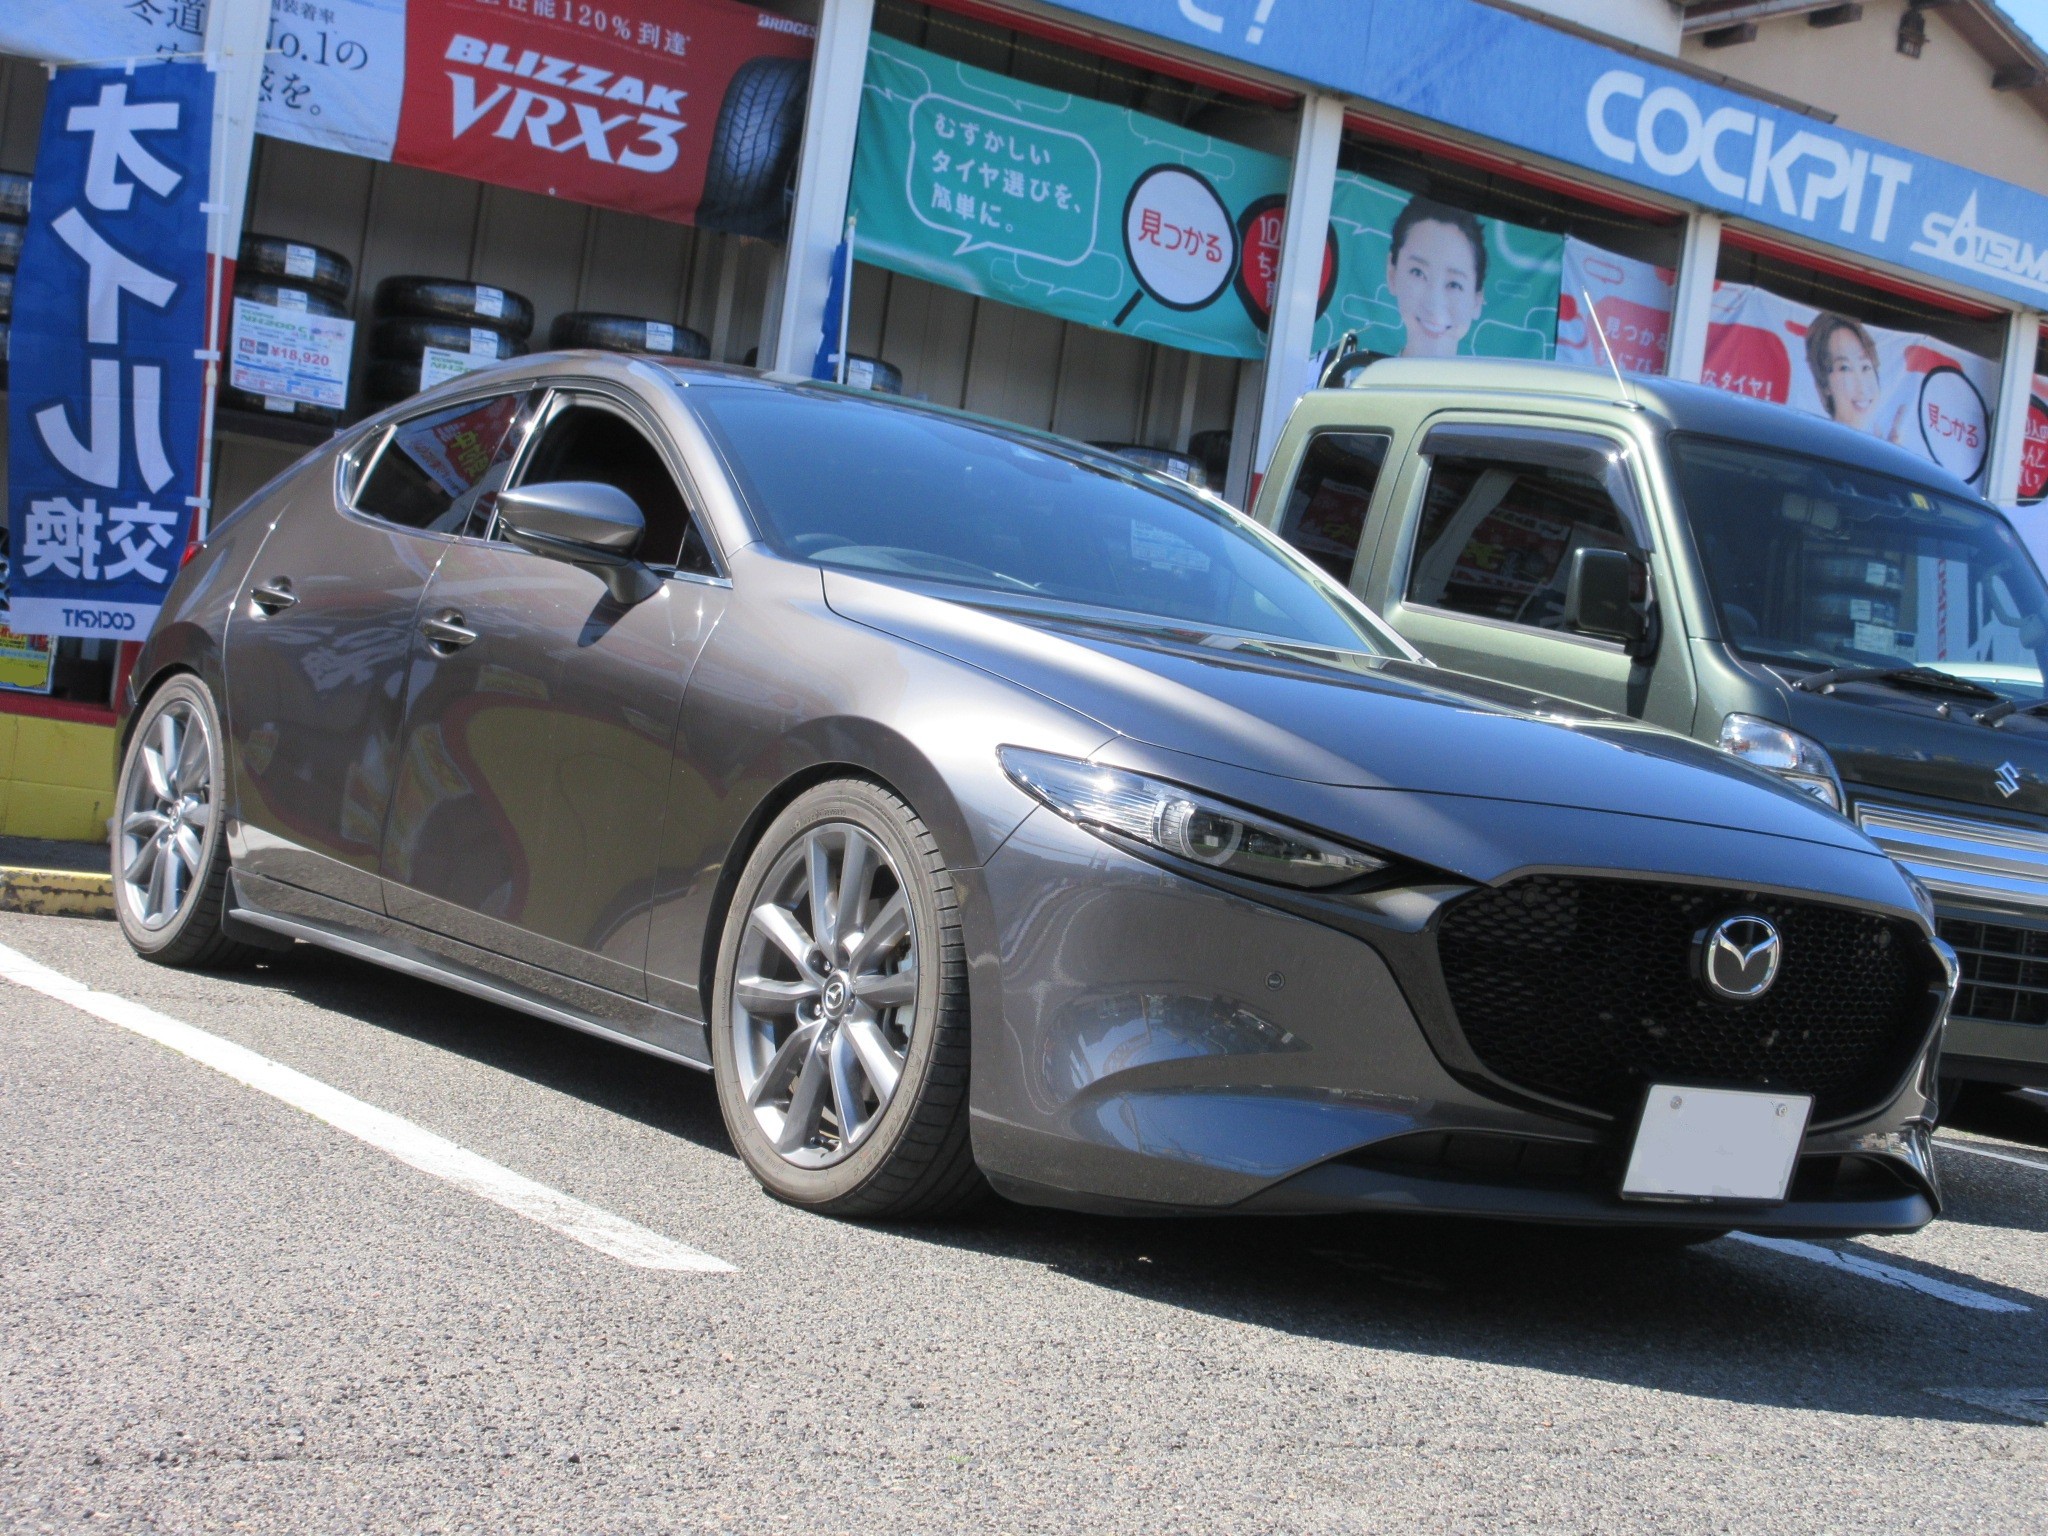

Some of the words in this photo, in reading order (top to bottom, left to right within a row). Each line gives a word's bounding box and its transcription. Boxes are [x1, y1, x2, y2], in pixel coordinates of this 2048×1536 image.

[444, 33, 688, 116] BLIZZAK
[444, 70, 688, 174] VRX3
[934, 112, 1050, 166] むずかしい
[1586, 69, 1913, 243] COCKPIT
[1138, 207, 1223, 264] 見つかる
[1928, 402, 1979, 449] 見つかる
